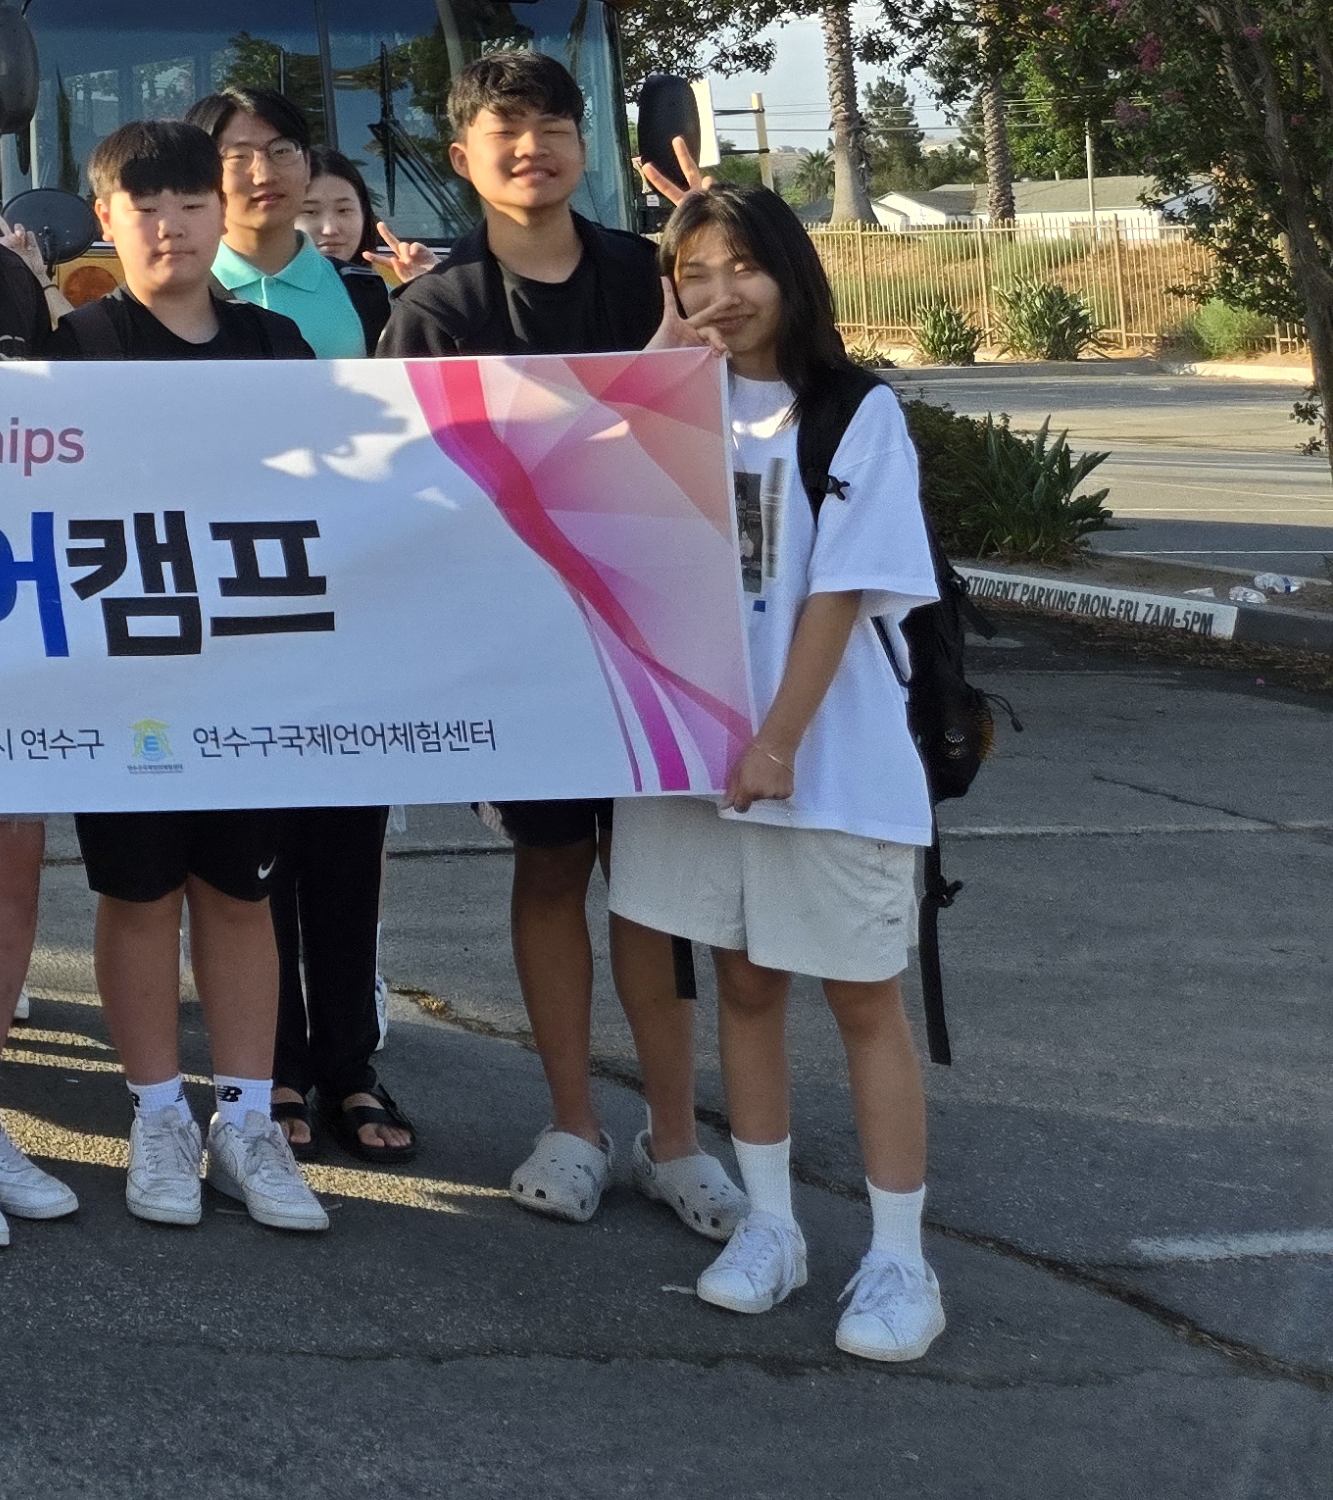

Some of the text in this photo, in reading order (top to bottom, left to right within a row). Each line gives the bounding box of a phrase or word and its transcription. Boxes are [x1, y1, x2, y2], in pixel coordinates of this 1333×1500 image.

[966, 575, 1020, 602] STUDENT
[1020, 583, 1076, 612] PARKING
[1078, 593, 1139, 623] MON-FRI
[20, 728, 105, 760] 연수구
[192, 719, 497, 758] 연수구국제언어체험센터
